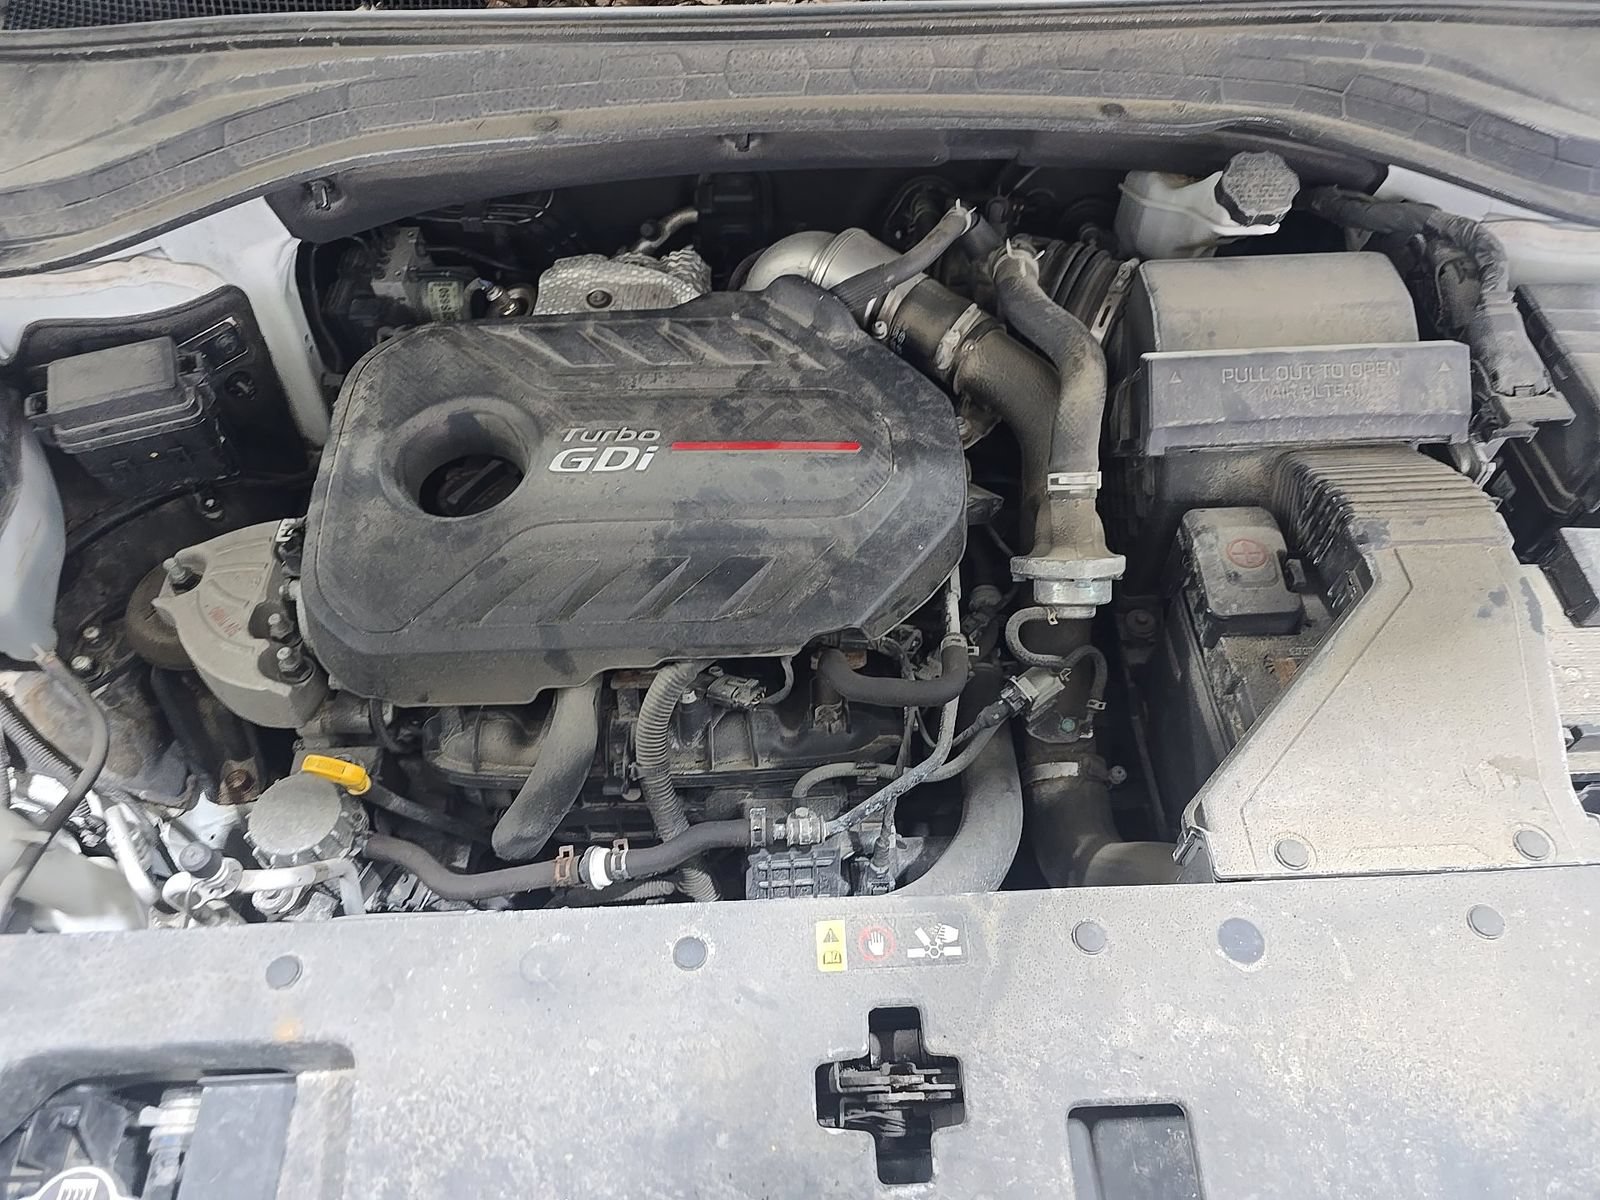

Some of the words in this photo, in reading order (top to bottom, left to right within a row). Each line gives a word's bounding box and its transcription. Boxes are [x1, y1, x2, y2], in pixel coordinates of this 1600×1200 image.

[1222, 367, 1270, 384] PULL
[1276, 364, 1314, 381] OUT
[1320, 363, 1344, 379] TO
[1350, 361, 1400, 380] OPEN
[561, 427, 661, 442] Turbo
[548, 446, 660, 472] GDi
